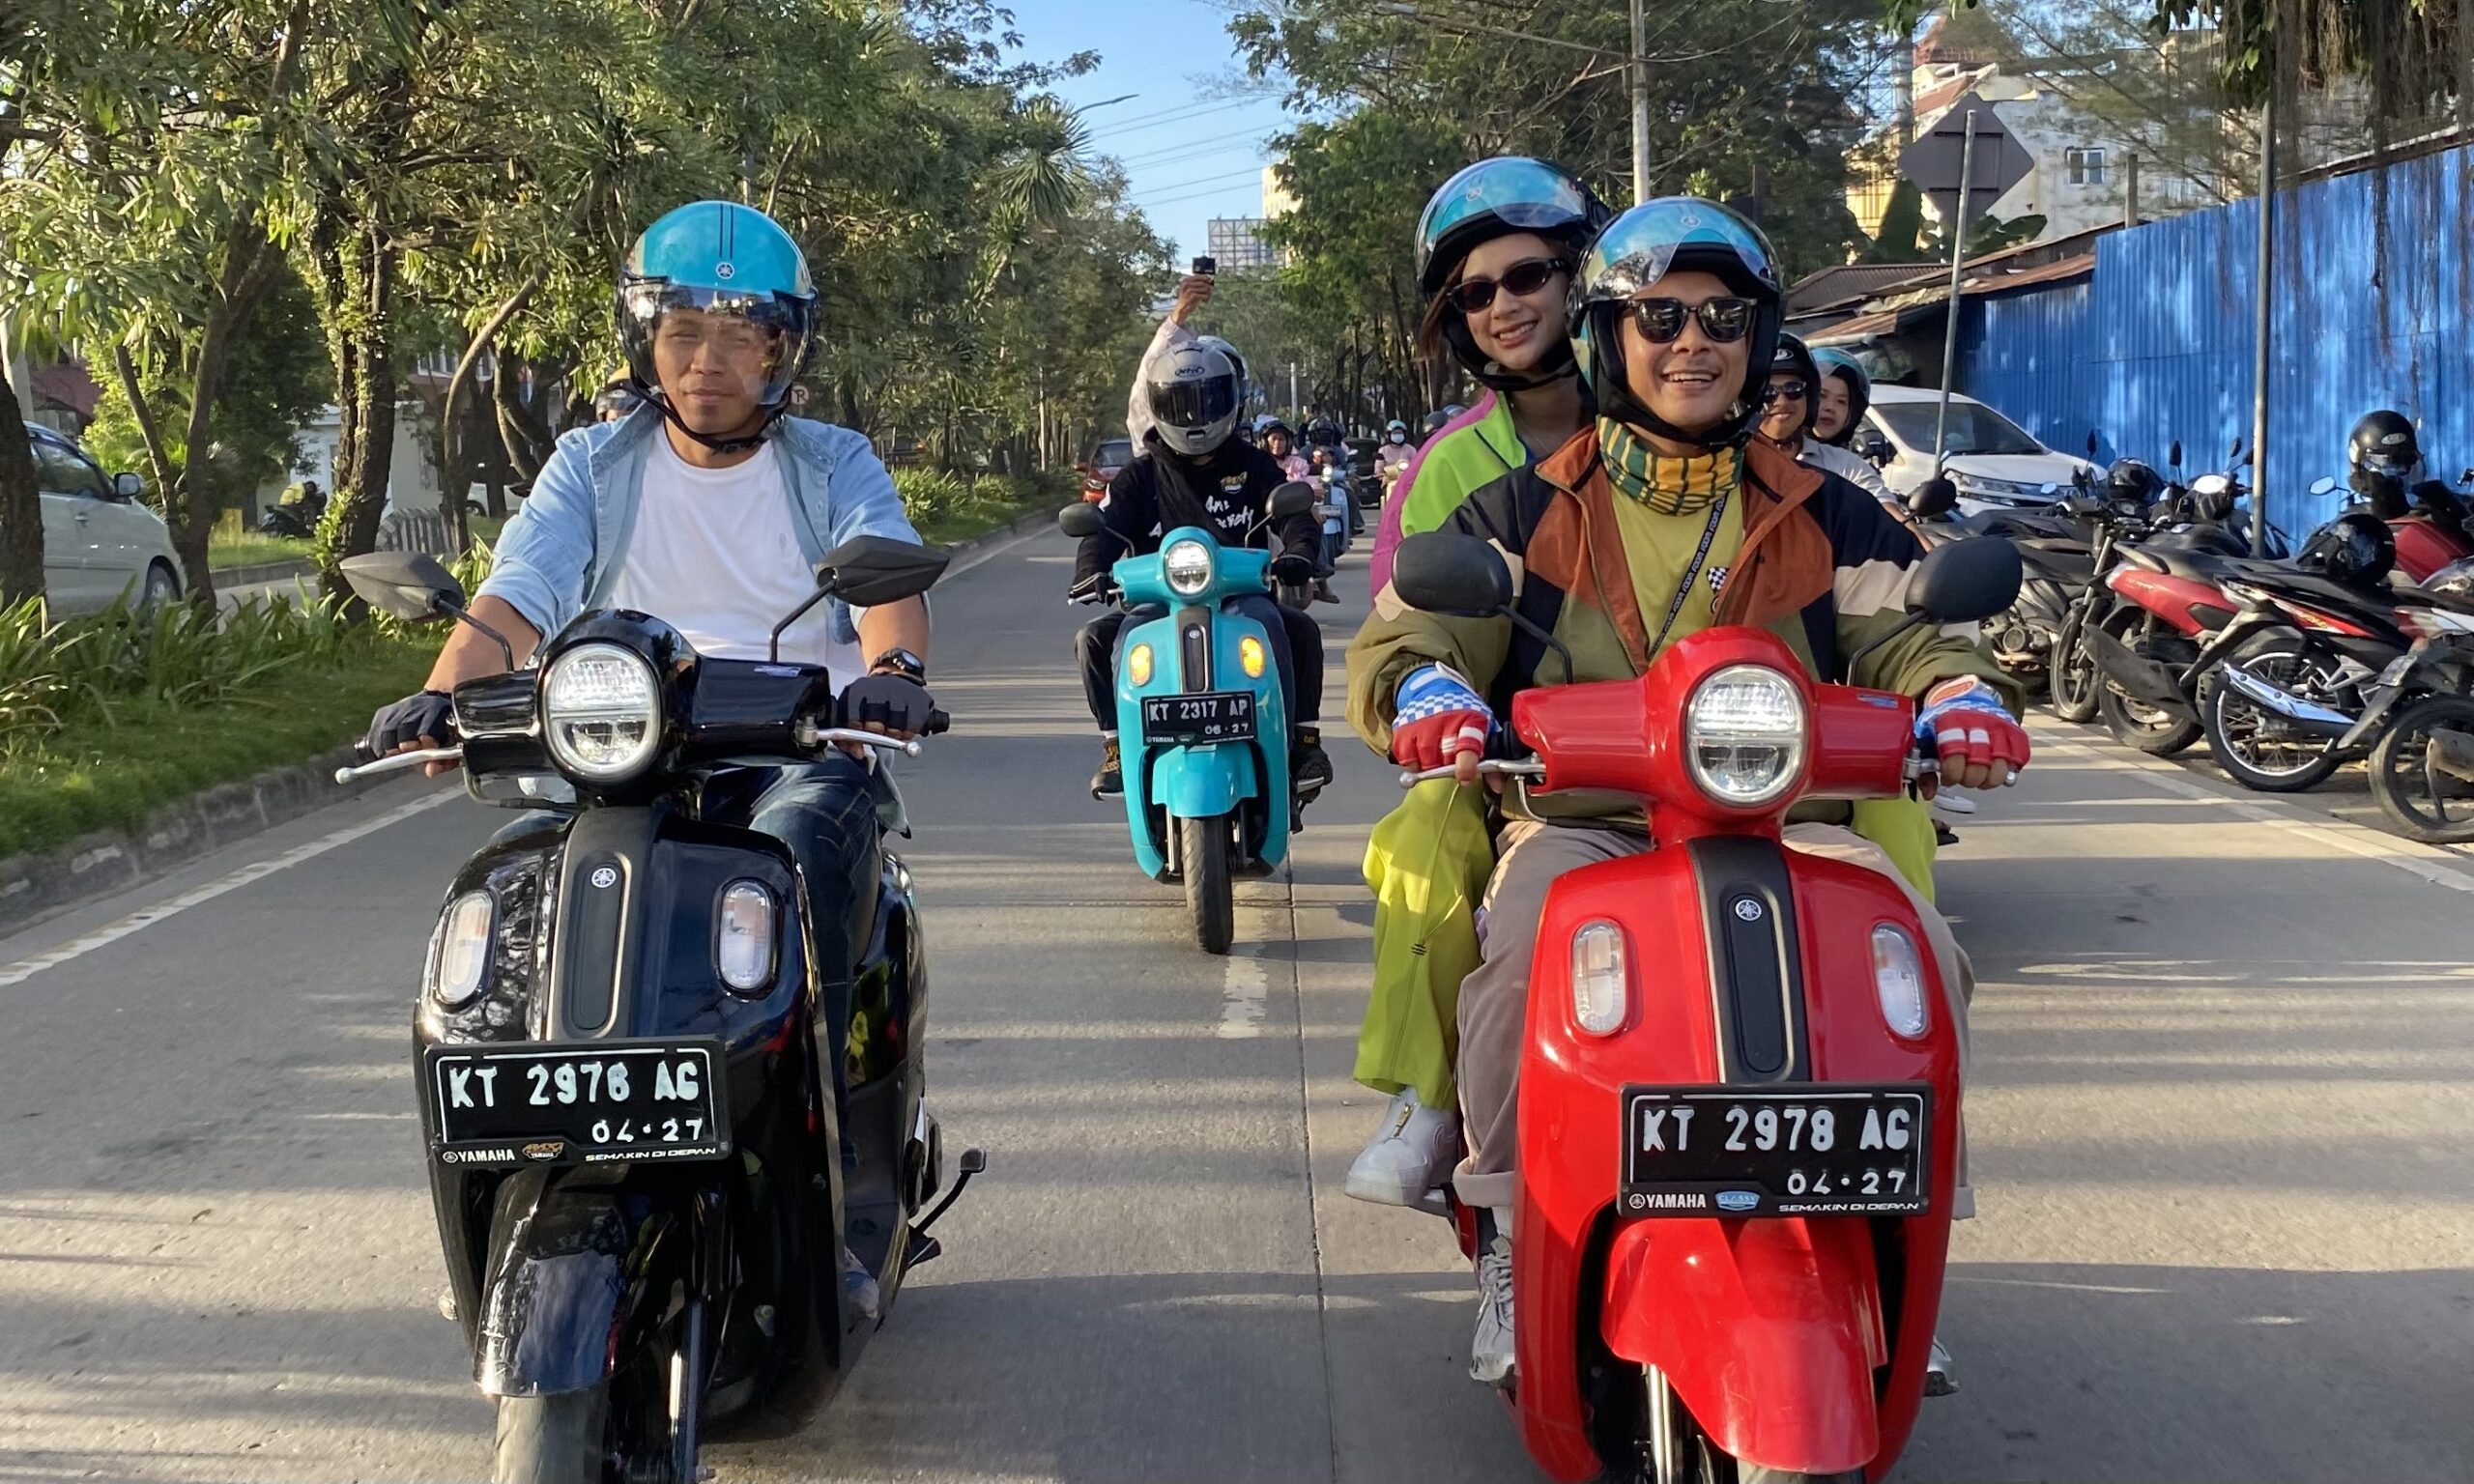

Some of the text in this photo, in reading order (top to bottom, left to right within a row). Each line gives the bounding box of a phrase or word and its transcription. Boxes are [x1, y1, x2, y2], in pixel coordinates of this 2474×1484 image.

[1149, 699, 1248, 722] KT 2317 AP
[449, 1067, 497, 1108] KT
[1643, 1107, 1695, 1152] KT
[1725, 1107, 1834, 1152] 2978
[457, 1148, 516, 1163] YAMAHA
[585, 1151, 650, 1162] SEMAKIN
[667, 1147, 716, 1157] DEPAN
[1646, 1193, 1707, 1209] YAMAHA
[1778, 1203, 1849, 1213] SEMAKIN
[1866, 1202, 1919, 1212] DEPAN
